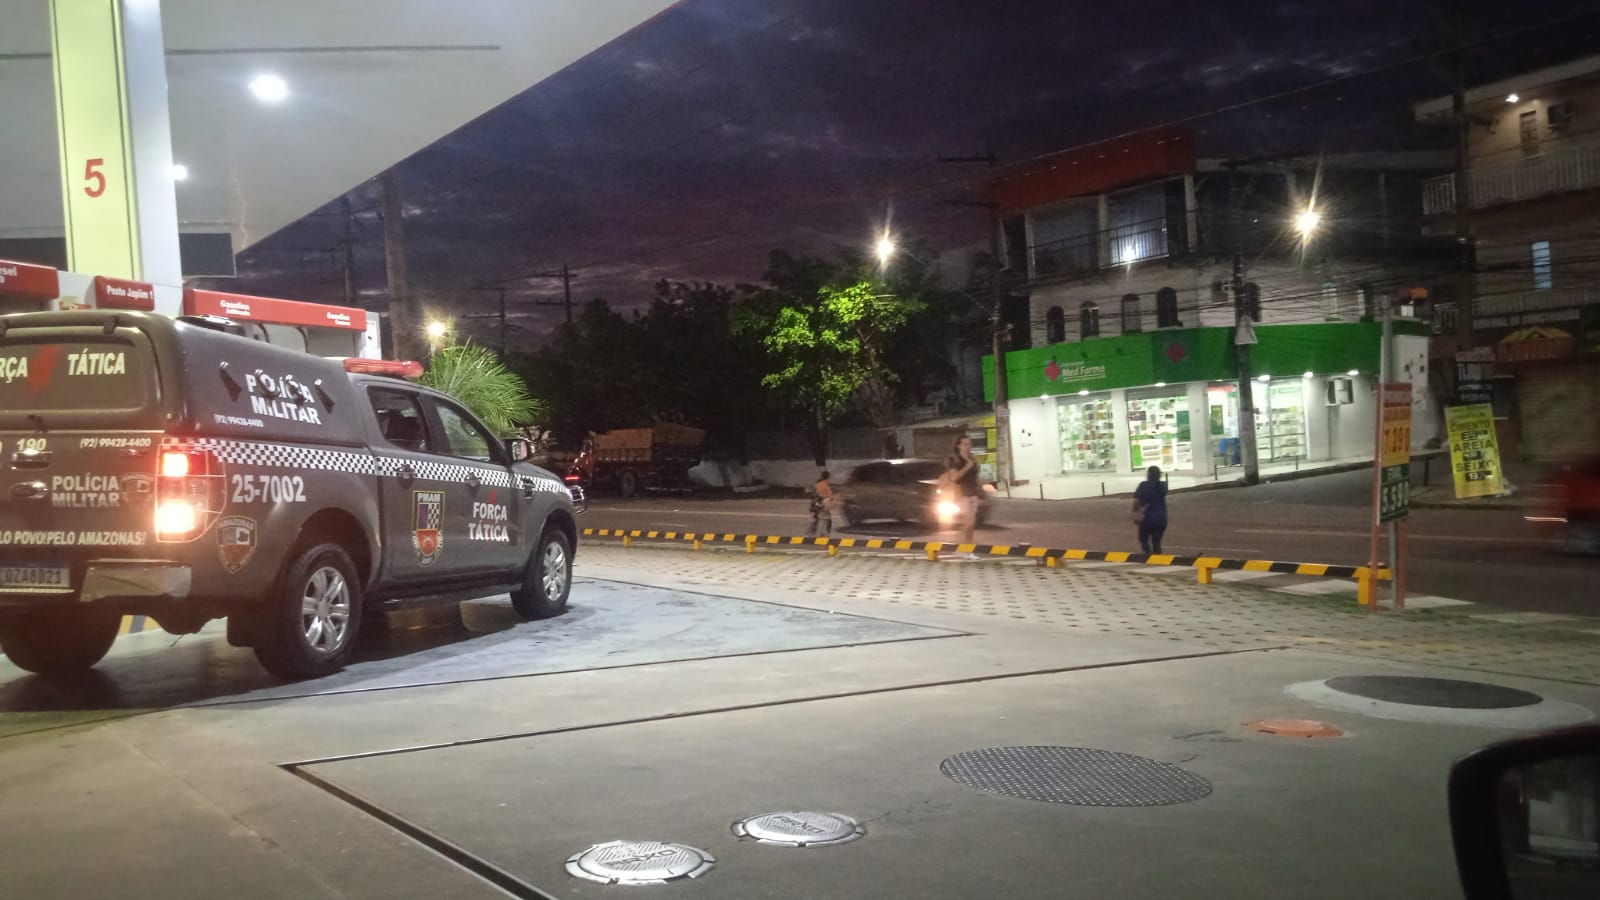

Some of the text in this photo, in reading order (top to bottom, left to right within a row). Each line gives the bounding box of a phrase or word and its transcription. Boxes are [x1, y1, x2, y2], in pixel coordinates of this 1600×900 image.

[84, 158, 106, 198] 5
[67, 348, 126, 376] TÁTICA
[245, 373, 315, 403] POÍCA
[250, 395, 322, 425] MILITAR
[16, 438, 47, 451] 190
[80, 437, 152, 448] (92) 99428-4400
[1453, 439, 1493, 453] AREIA
[52, 472, 120, 491] POLÍCIA
[231, 474, 307, 504] 25-7002
[52, 492, 120, 508] MILITAR
[472, 501, 508, 524] FORÇA
[468, 520, 510, 543] TÁTICA
